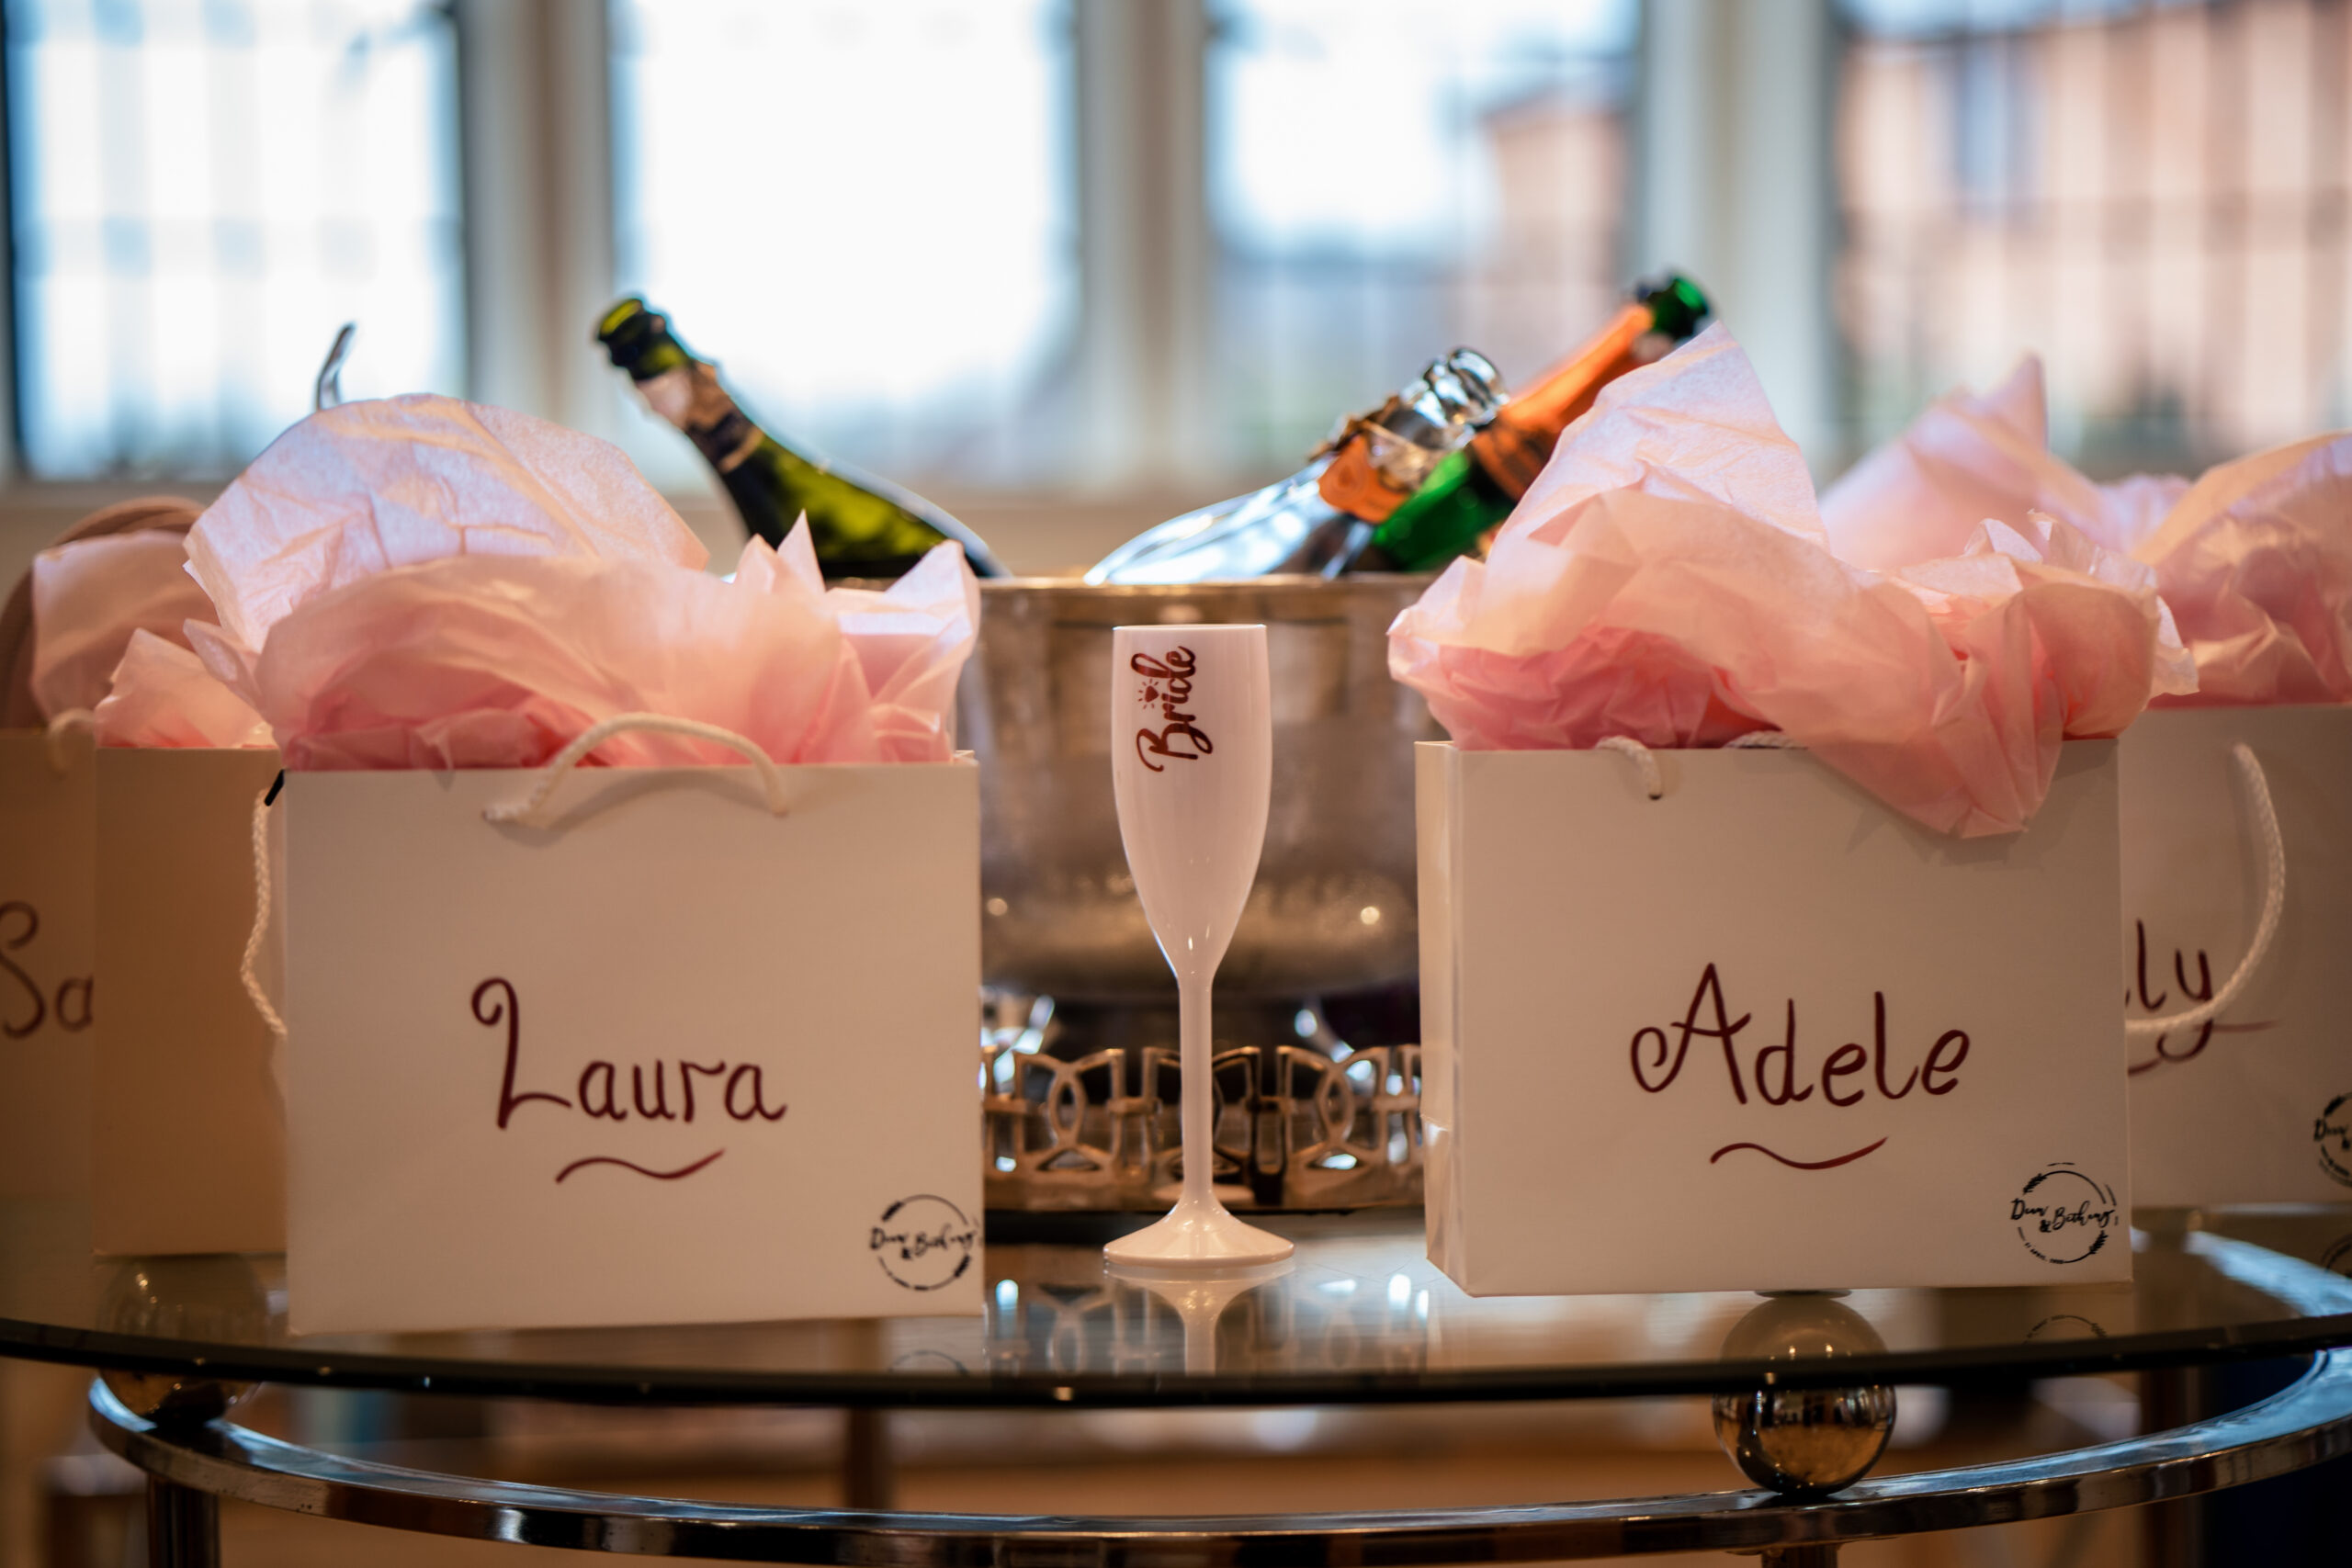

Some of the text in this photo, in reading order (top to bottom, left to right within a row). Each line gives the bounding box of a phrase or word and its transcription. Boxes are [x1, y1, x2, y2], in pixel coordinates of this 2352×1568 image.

[1130, 645, 1214, 773] Bride
[470, 976, 787, 1131] Laura
[1630, 962, 1971, 1108] Adele
[2124, 918, 2214, 1065] ly
